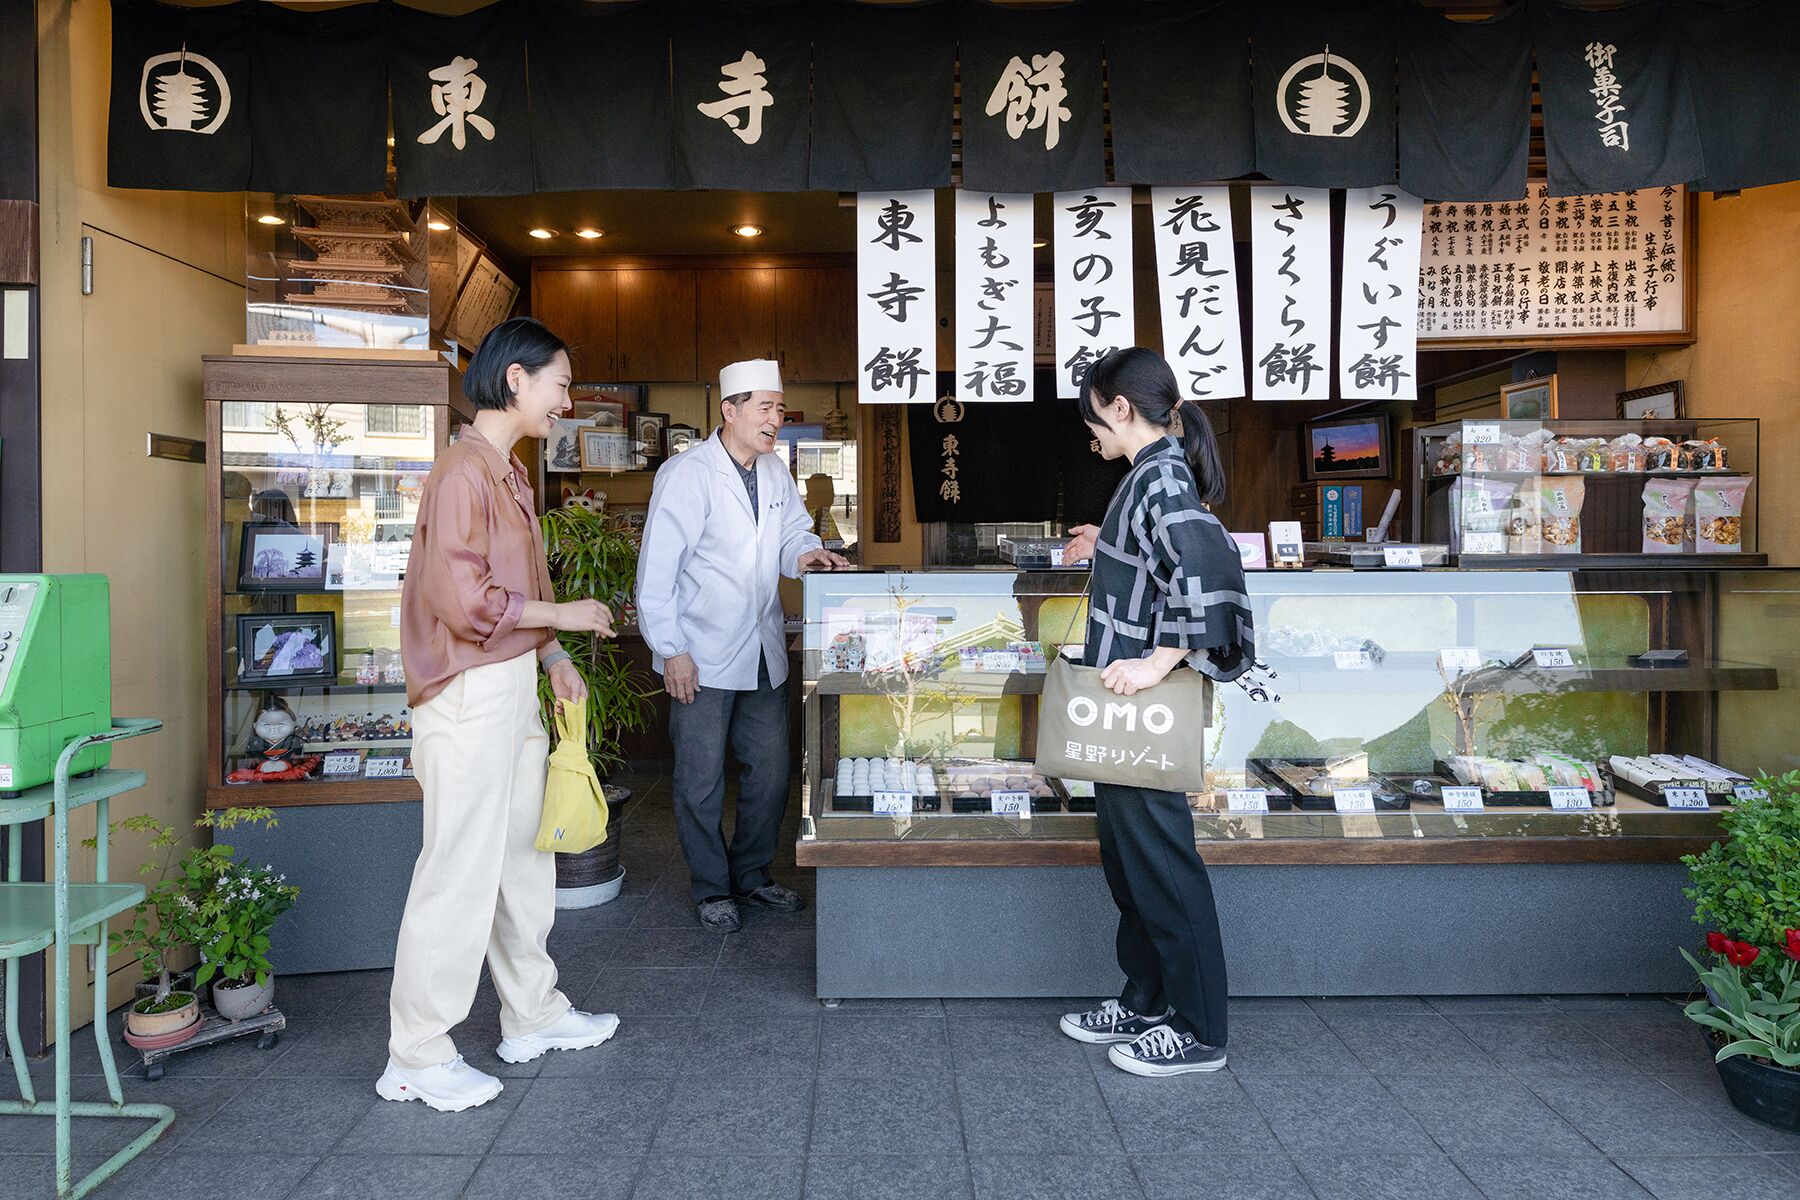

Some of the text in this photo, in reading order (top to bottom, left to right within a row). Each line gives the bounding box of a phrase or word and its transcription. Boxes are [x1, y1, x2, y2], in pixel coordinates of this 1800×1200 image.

[1584, 41, 1629, 152] 御菓子司
[1555, 196, 1569, 229] 業祝
[1572, 195, 1586, 229] 三詣り
[1660, 185, 1677, 283] 今も昔も伝統の
[1426, 266, 1437, 309] みな月
[1440, 264, 1451, 308] 氏神祭礼
[1491, 263, 1503, 307] 正月祝餅
[1536, 261, 1550, 305] 敬老の日
[1553, 260, 1568, 305] 開店祝
[1571, 260, 1585, 304] 新築祝
[1624, 259, 1638, 303] 出産祝
[1643, 231, 1659, 311] 生菓子行事
[865, 198, 931, 400] 東寺餅
[963, 196, 1027, 396] よもぎ大福
[1161, 196, 1230, 395] 花見だんご
[1258, 193, 1323, 396] さくら餅
[1348, 194, 1411, 396] うぐいす餅
[1517, 267, 1532, 325] 一年の行事
[1473, 435, 1492, 443] 320
[939, 433, 961, 505] 東寺餅
[1398, 557, 1410, 565] 60
[1550, 658, 1564, 666] 150
[1066, 696, 1175, 735] OMO
[377, 768, 399, 776] 1,000
[1064, 741, 1175, 771] 星野リゾート
[886, 803, 903, 811] 150
[1003, 803, 1020, 811] 150
[1243, 801, 1259, 810] 150
[1457, 799, 1473, 808] 150
[1566, 799, 1583, 808] 130
